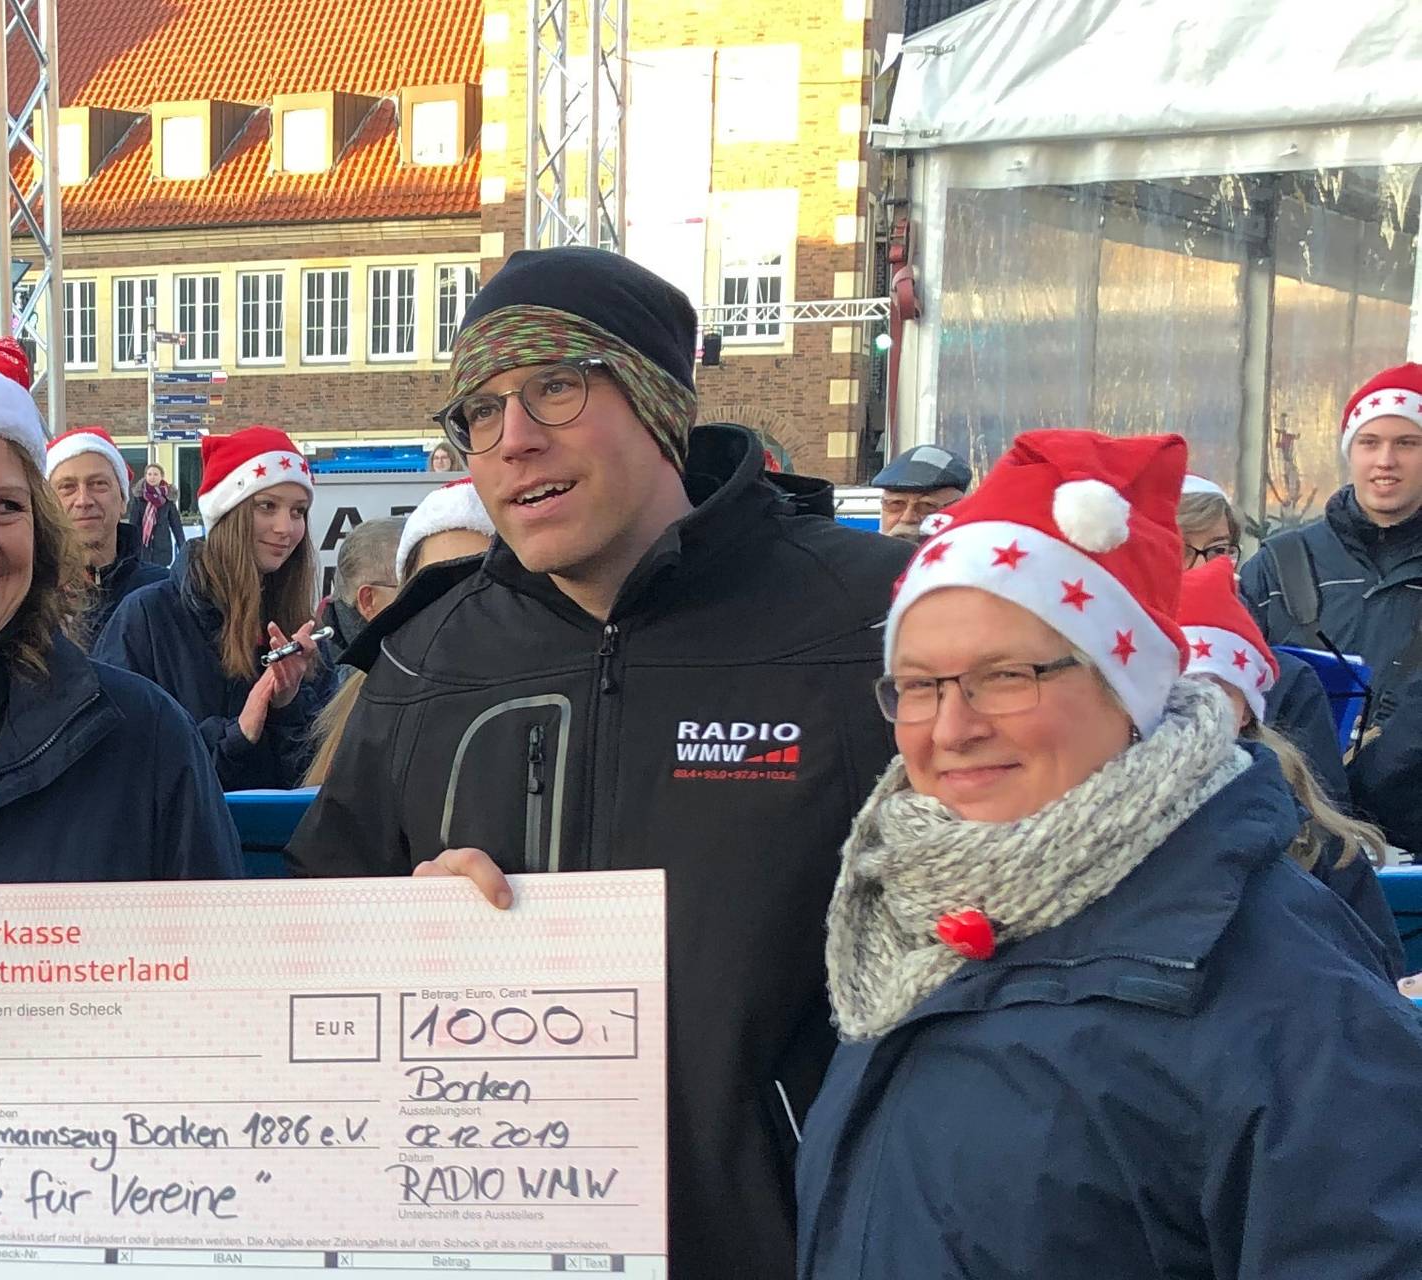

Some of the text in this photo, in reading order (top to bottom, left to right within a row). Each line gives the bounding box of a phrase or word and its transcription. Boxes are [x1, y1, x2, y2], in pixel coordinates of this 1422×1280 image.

[678, 721, 801, 741] RADIO
[676, 743, 747, 762] WMW
[421, 988, 527, 1001] Betrag: Euro, Cent
[17, 1003, 64, 1017] diesen
[69, 1002, 122, 1017] Scheck
[315, 1021, 356, 1036] EUR
[405, 1065, 531, 1104] Borken
[399, 1105, 482, 1118] Ausstellungsort
[122, 1112, 229, 1147] Borken
[242, 1111, 312, 1149] 1886
[398, 1153, 434, 1163] Datum
[385, 1163, 619, 1207] RADIO WMW
[25, 1170, 92, 1219] für
[398, 1208, 544, 1220] Unterschrift des Ausstellers
[213, 1252, 243, 1264] IBAN
[432, 1256, 471, 1269] Betrag
[583, 1257, 608, 1269] Text
